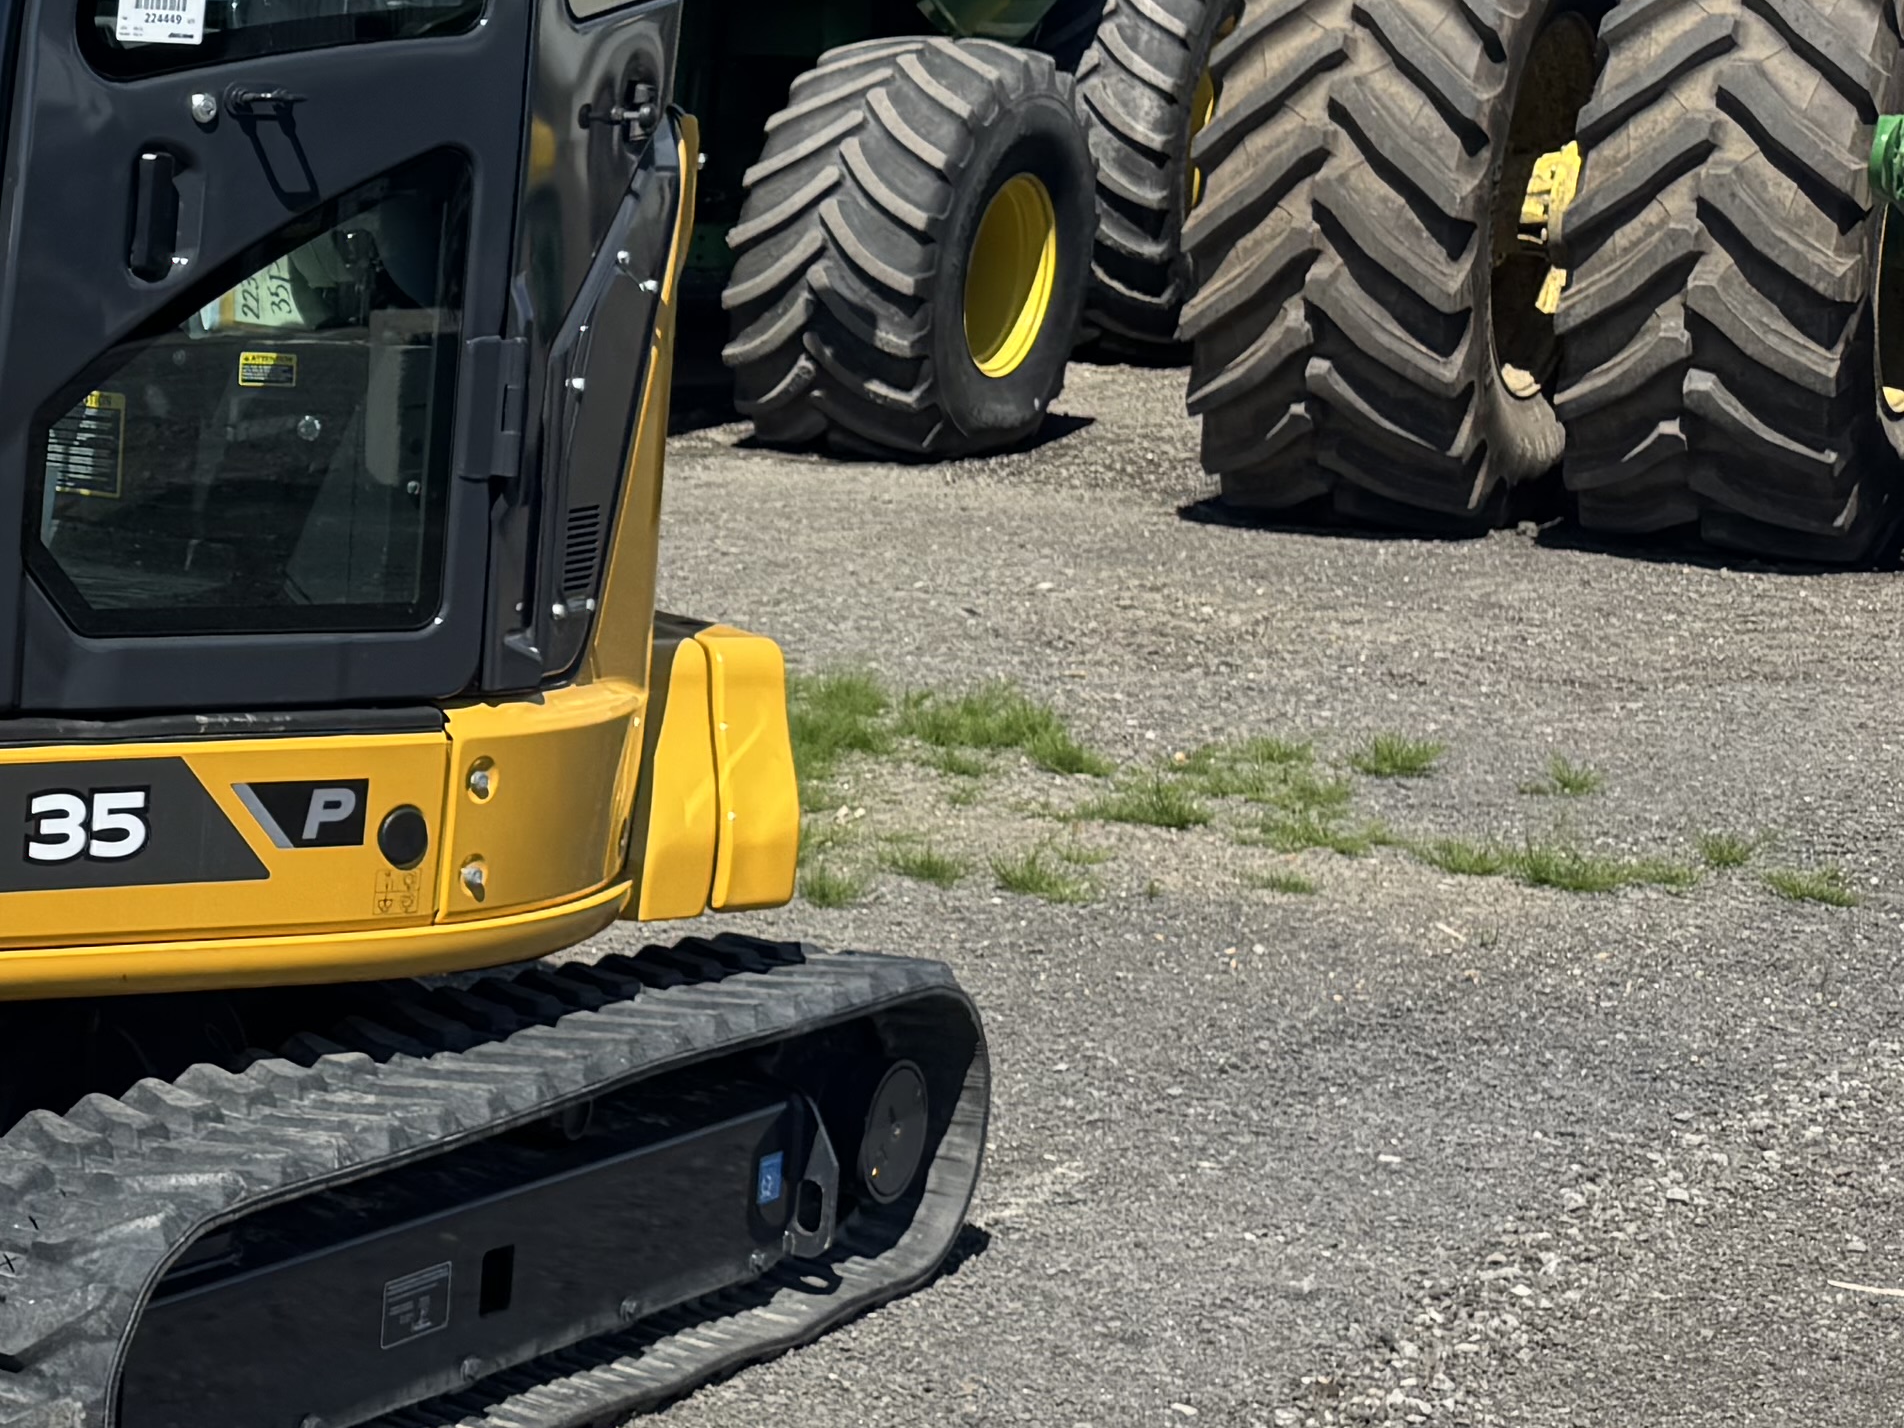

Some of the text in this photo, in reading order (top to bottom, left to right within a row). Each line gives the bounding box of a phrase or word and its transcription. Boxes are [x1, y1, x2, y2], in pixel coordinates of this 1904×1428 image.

[144, 13, 183, 25] 224449
[28, 791, 146, 861] 35
[301, 788, 356, 839] P
